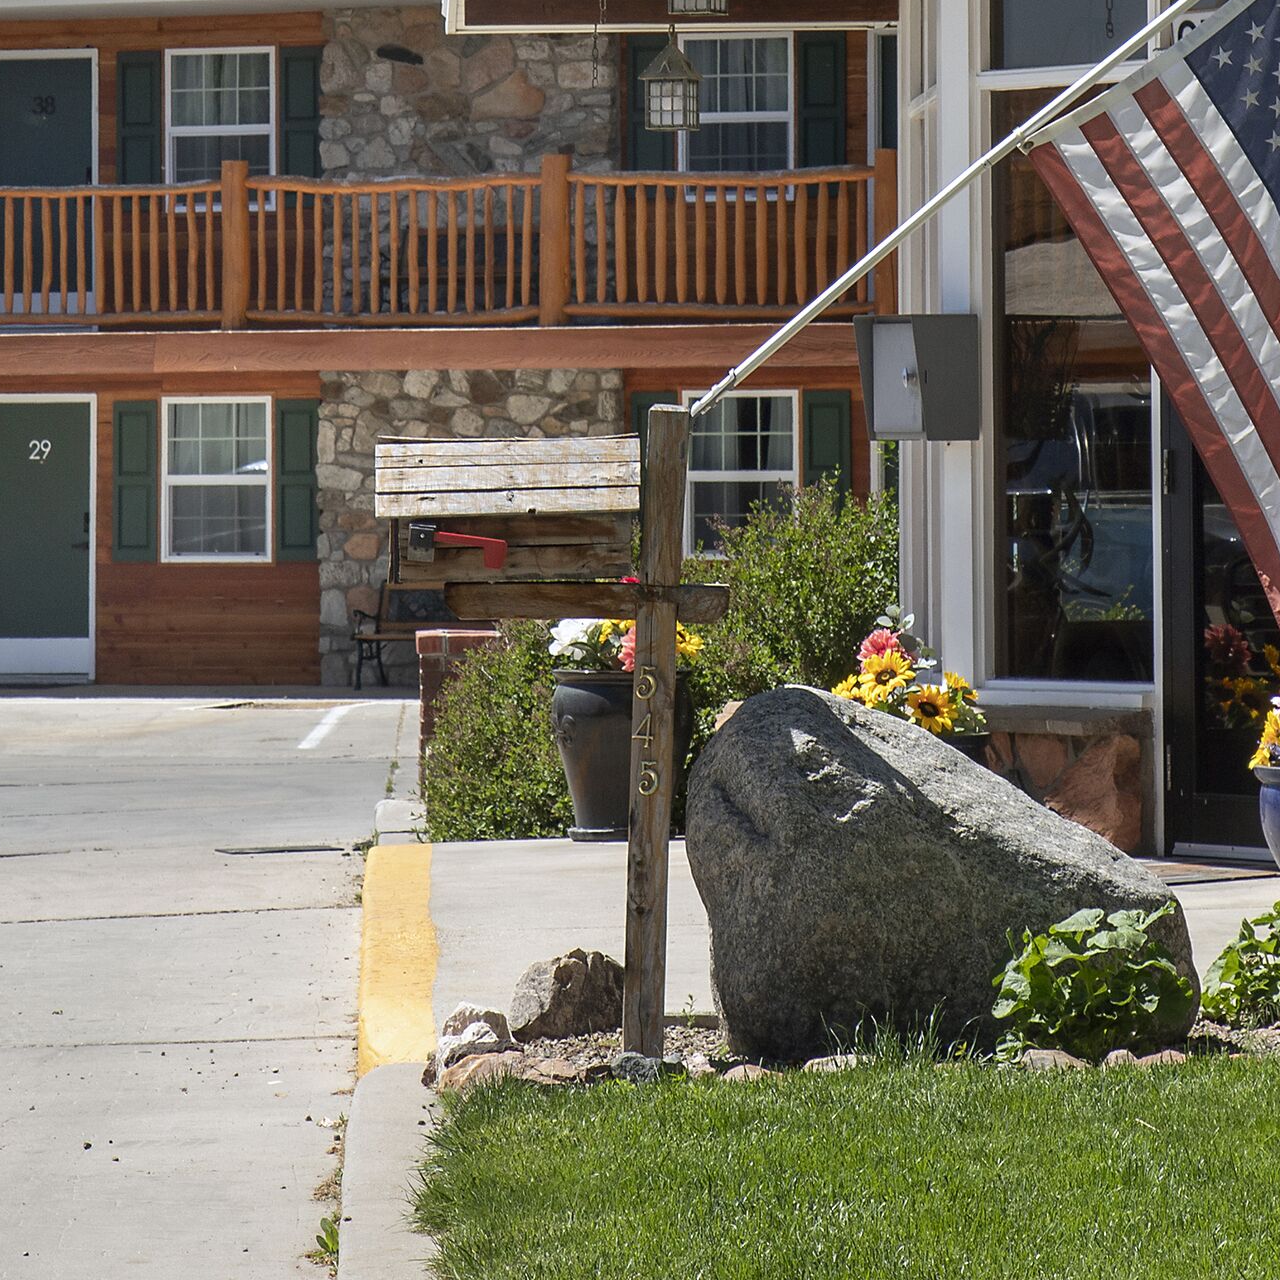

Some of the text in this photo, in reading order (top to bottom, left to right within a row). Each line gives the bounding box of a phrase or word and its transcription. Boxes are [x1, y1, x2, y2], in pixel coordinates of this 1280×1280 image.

[30, 95, 56, 115] 38
[28, 439, 52, 460] 29
[631, 665, 658, 796] 545
